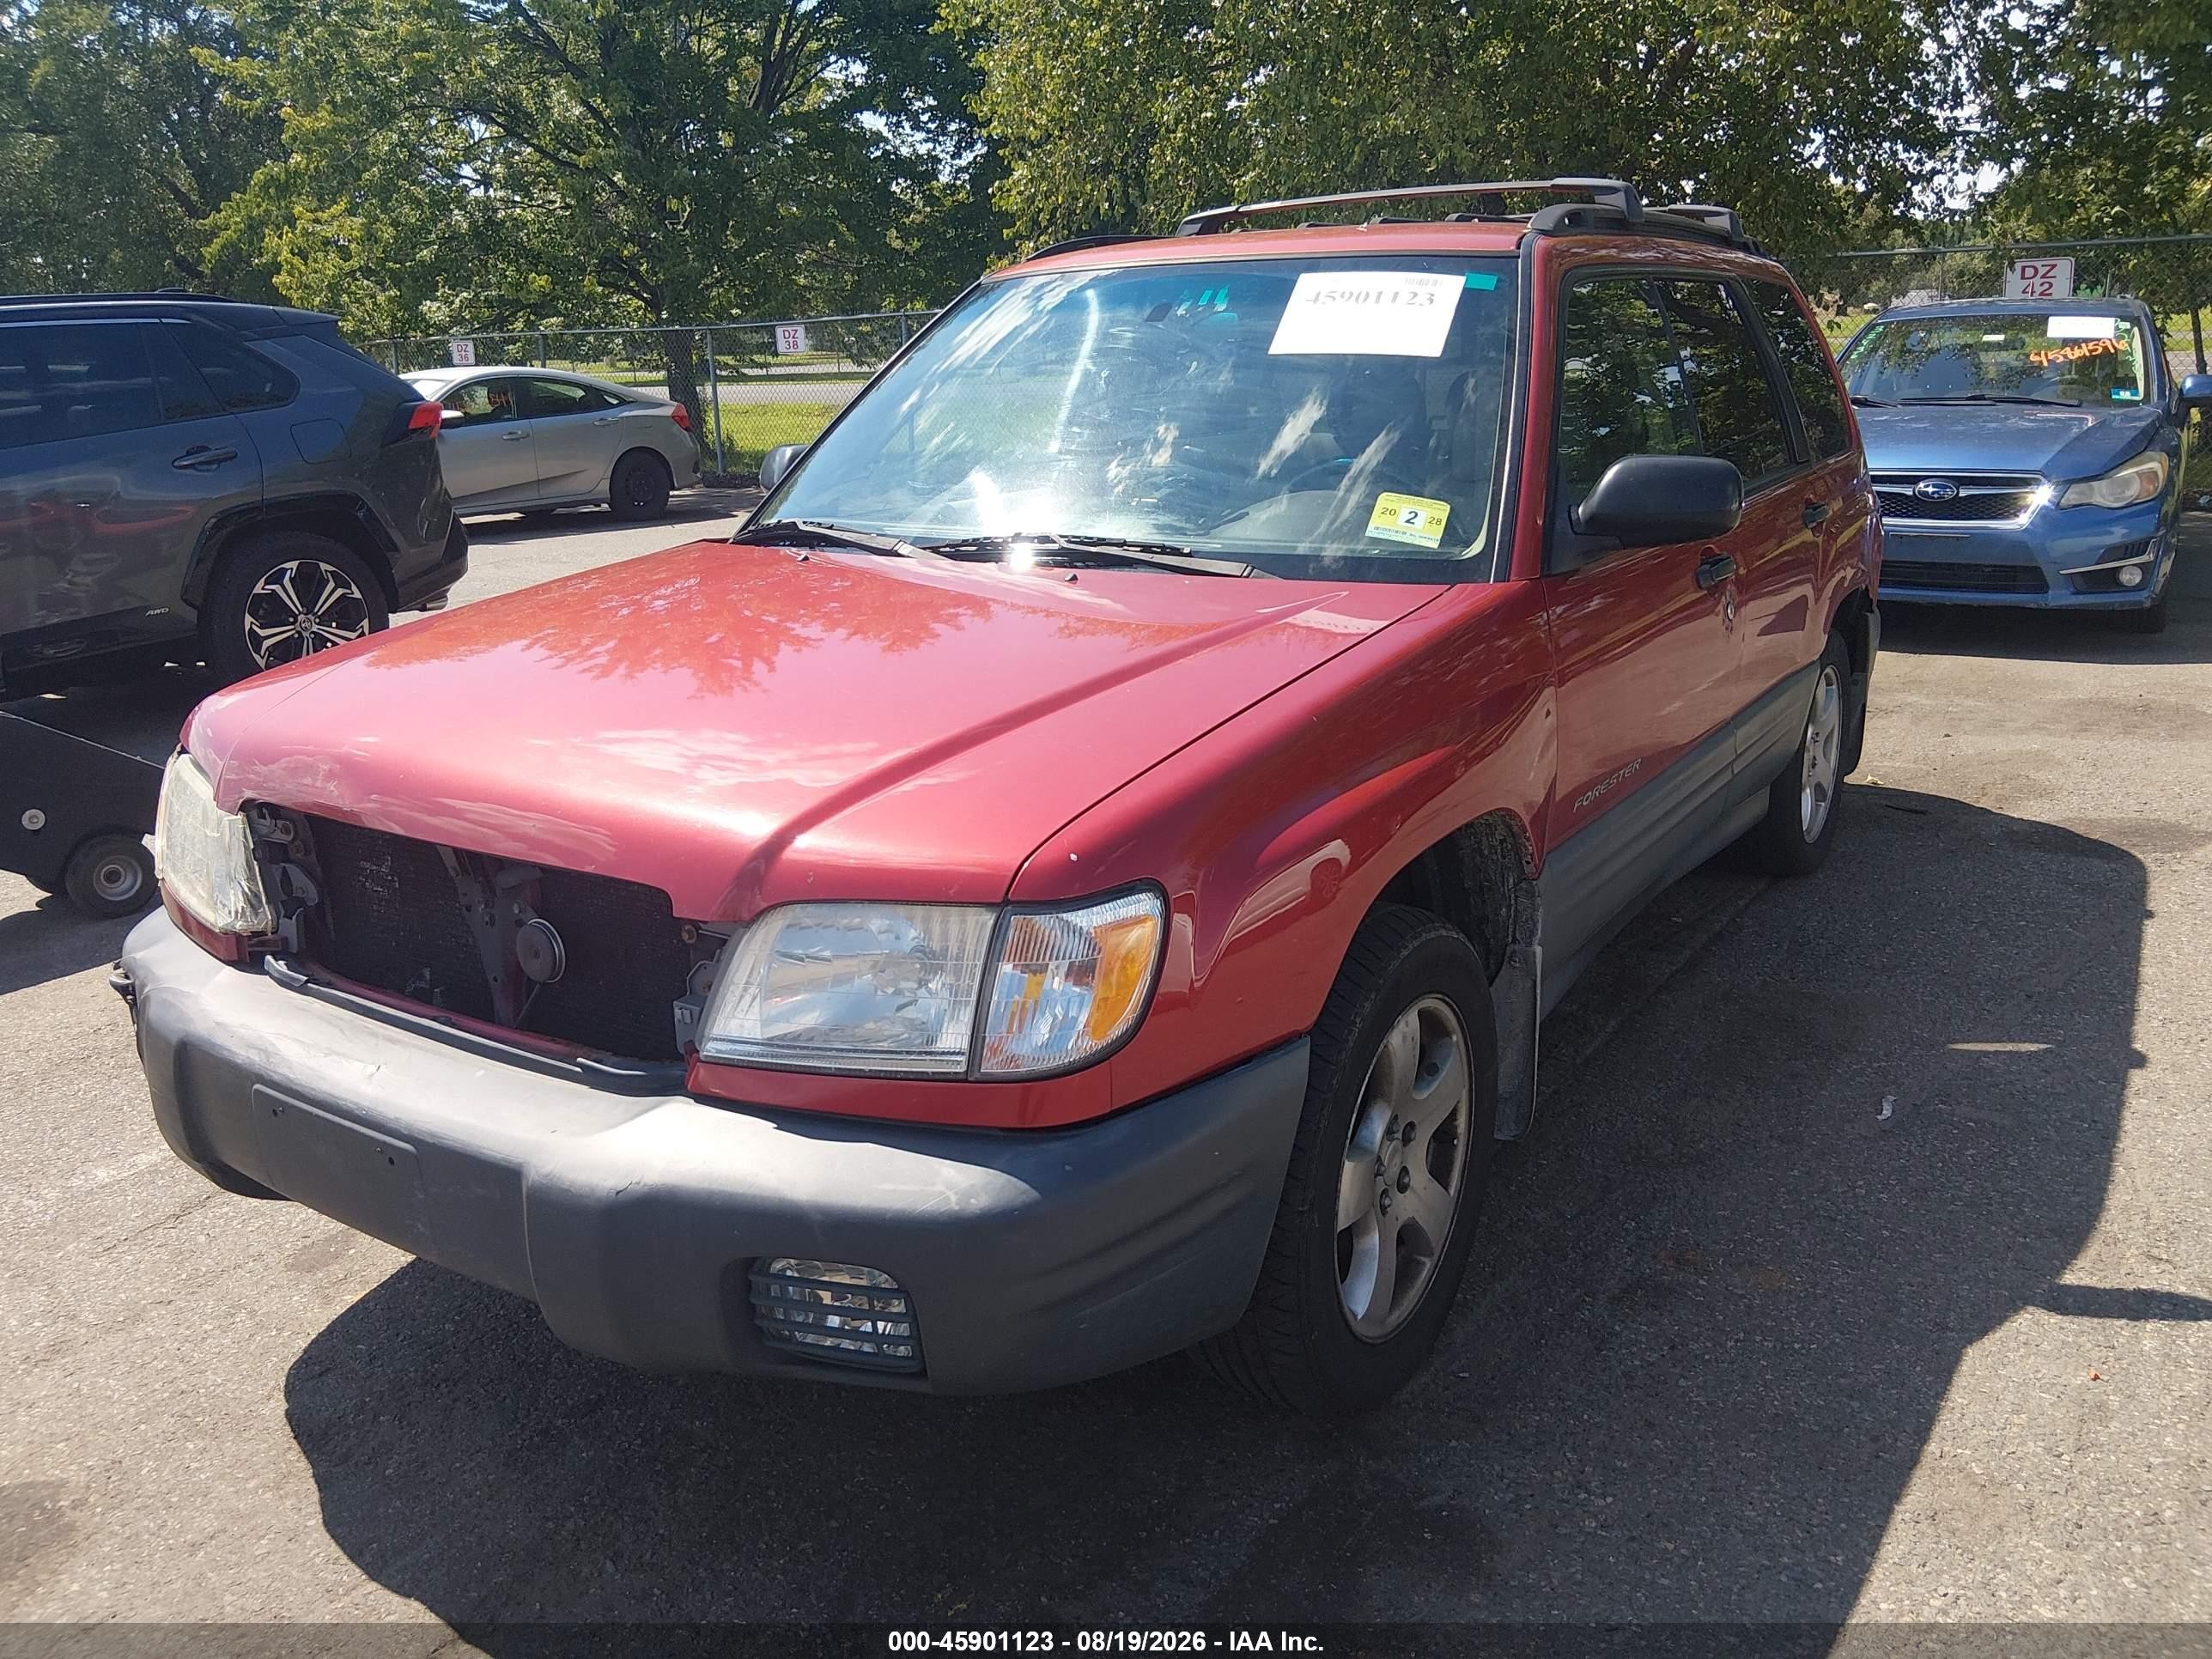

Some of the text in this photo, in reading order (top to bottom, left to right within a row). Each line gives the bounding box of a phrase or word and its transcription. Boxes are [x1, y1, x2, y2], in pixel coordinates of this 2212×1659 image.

[2021, 264, 2058, 280] DZ
[2021, 281, 2054, 297] 42
[1305, 290, 1435, 306] 45901123
[782, 330, 799, 339] DZ
[457, 344, 469, 353] DZ
[785, 340, 799, 349] 38
[459, 353, 469, 362] 36
[1381, 507, 1443, 526] 20 2 28
[145, 607, 169, 617] AWD
[1573, 758, 1641, 813] FORESTER
